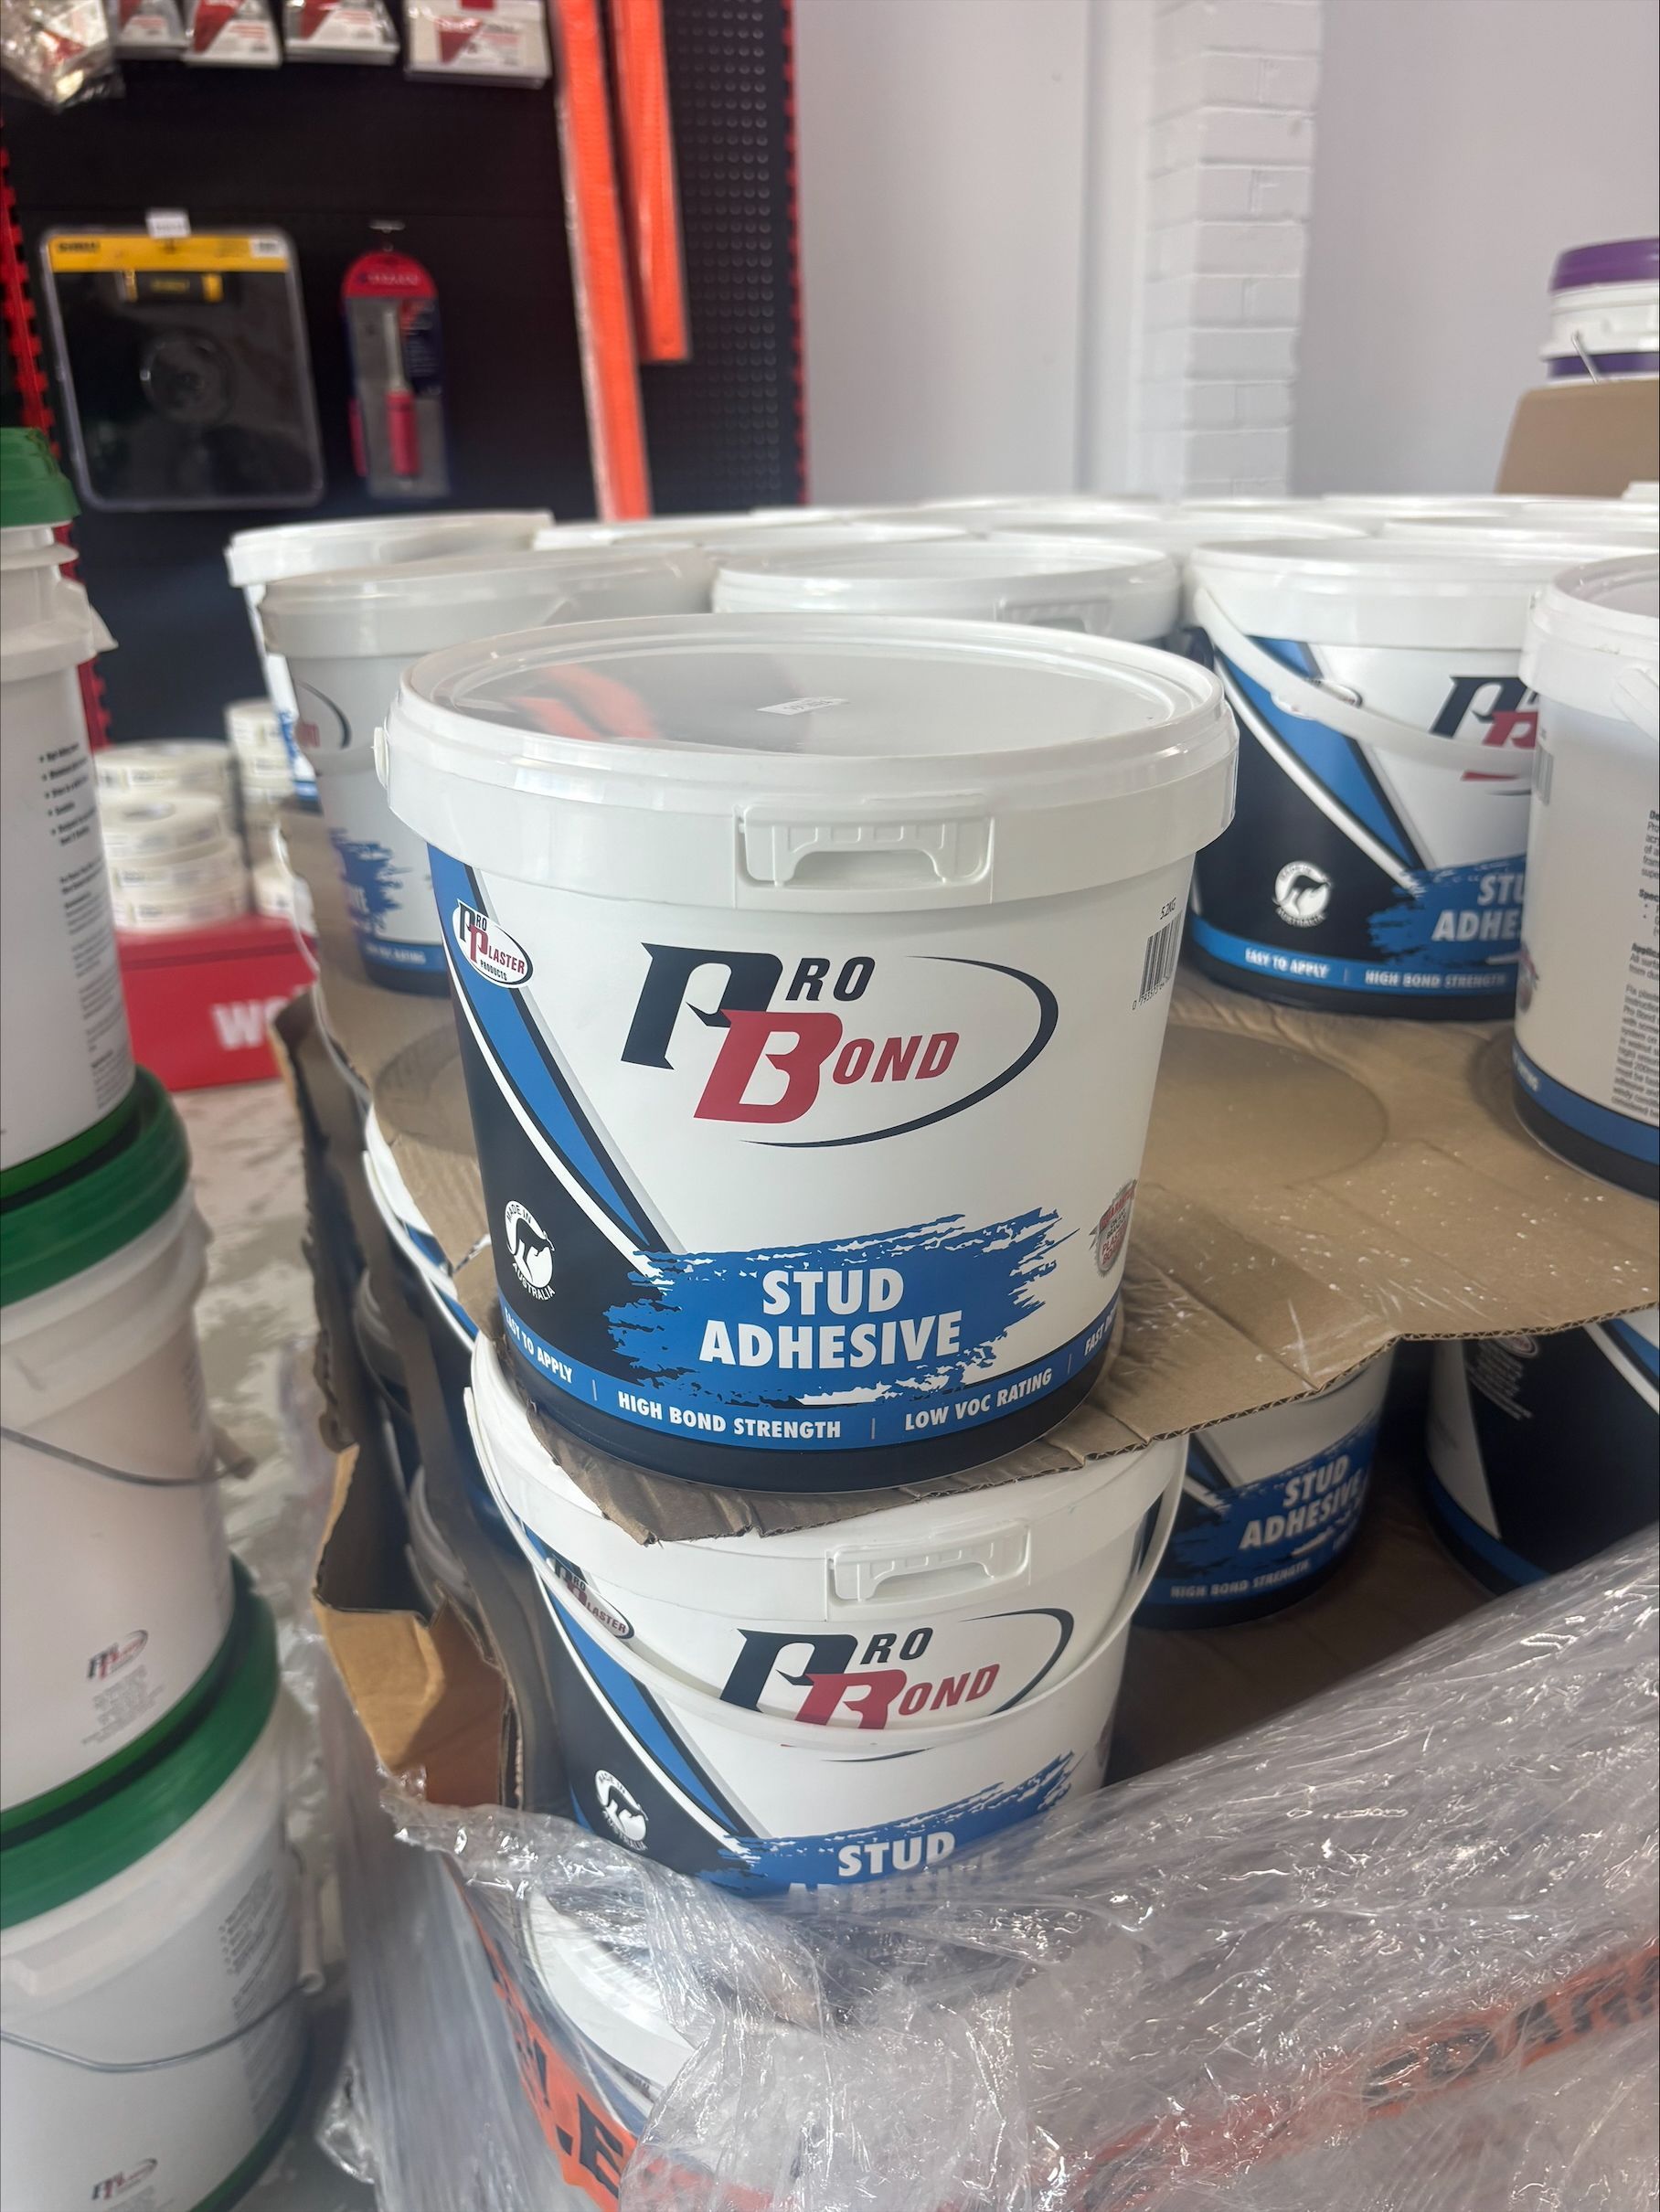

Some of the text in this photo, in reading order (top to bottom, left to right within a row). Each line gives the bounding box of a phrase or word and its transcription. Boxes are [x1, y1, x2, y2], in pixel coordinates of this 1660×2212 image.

[459, 902, 488, 942] PRO
[470, 923, 526, 974] PLASTER
[480, 959, 508, 982] PRODUCTS
[1245, 946, 1330, 980] EASY TO APPLY
[1365, 969, 1399, 987] HIGH
[1402, 971, 1441, 988] BOND
[621, 942, 876, 1070] PRO
[693, 1008, 960, 1124] BOND
[506, 1204, 532, 1224] MADE IN
[513, 1262, 555, 1301] AUSTRALIA
[762, 1268, 904, 1315] STUD
[521, 1330, 535, 1356] TO
[537, 1345, 573, 1384] APPLY
[699, 1310, 963, 1369] ADHESIVE
[1084, 1322, 1105, 1356] FAST
[617, 1390, 841, 1439] HIGH BOND STRENGTH
[905, 1367, 1052, 1430] LOW VOC RATING
[1282, 1454, 1350, 1508] STUD
[1170, 1558, 1312, 1599] HIGH BOND STRENGTH
[718, 1626, 933, 1716] PRO
[838, 1831, 955, 1877] STUD
